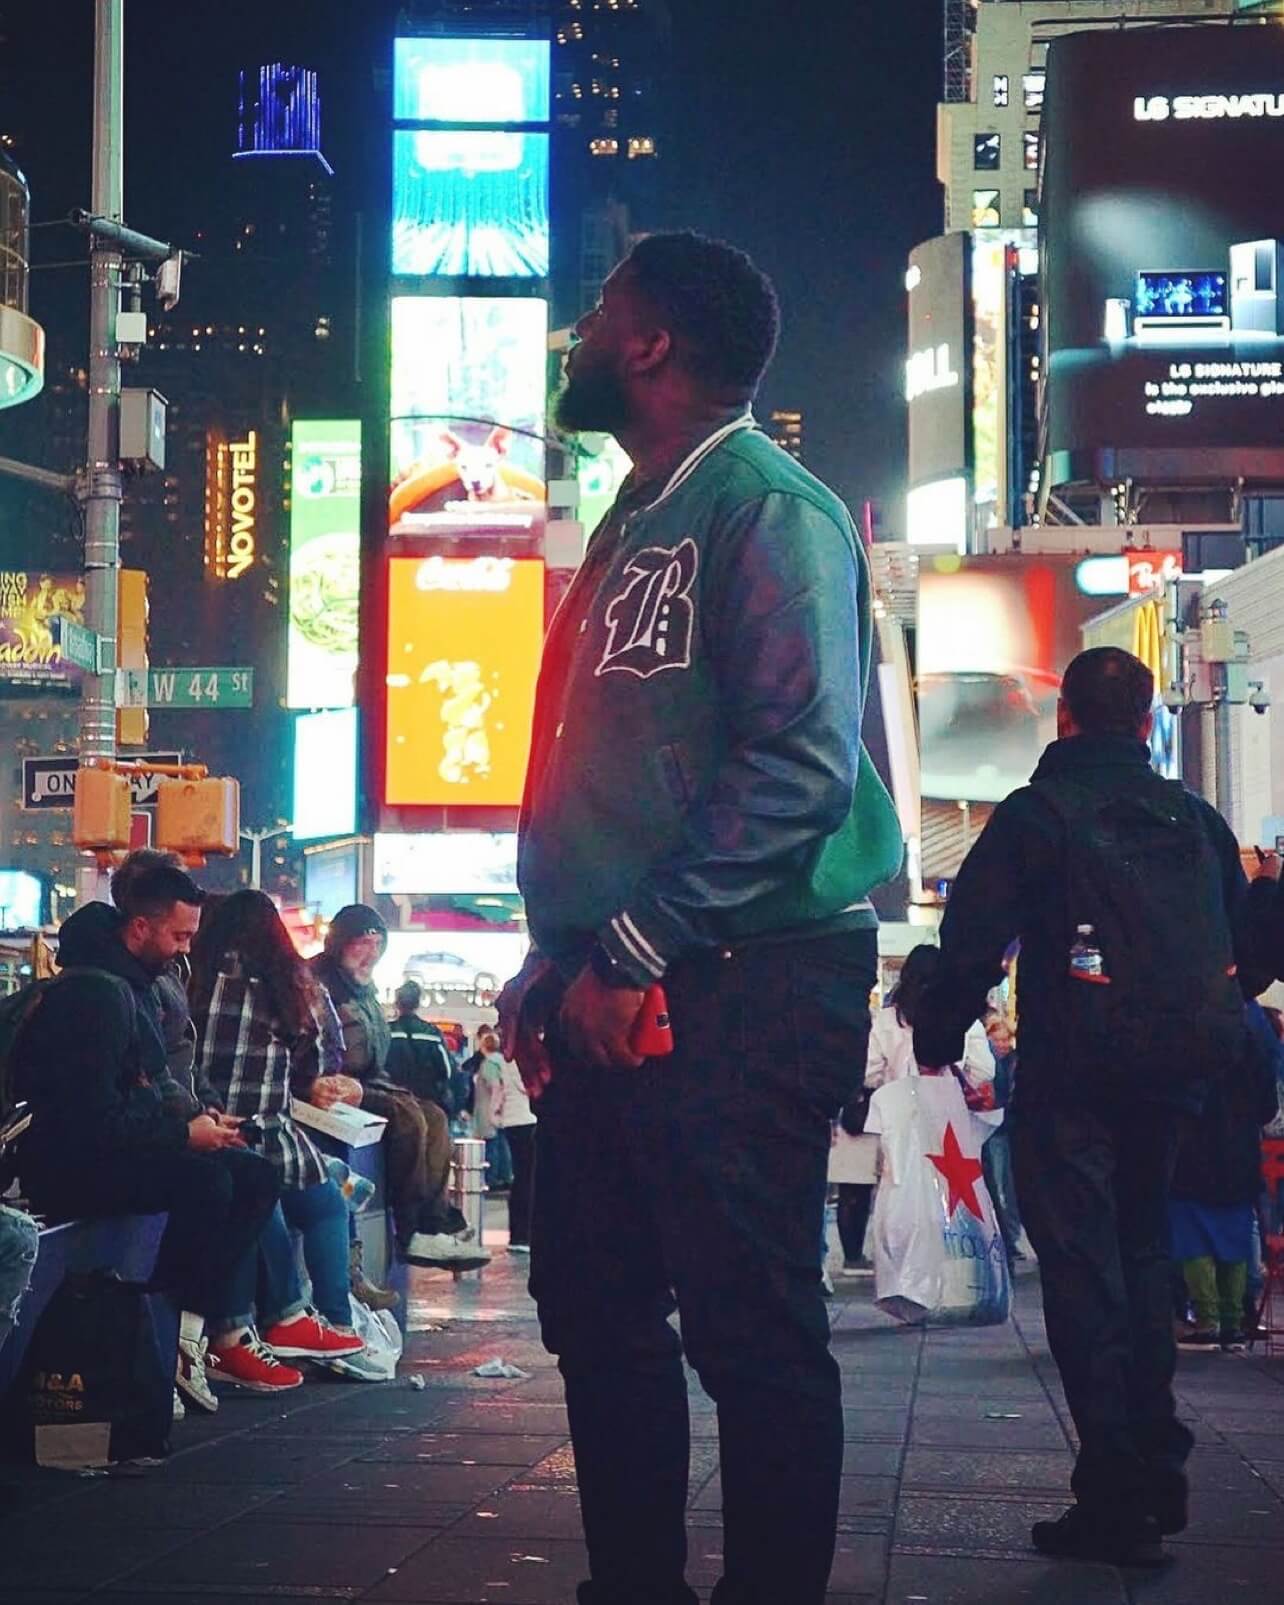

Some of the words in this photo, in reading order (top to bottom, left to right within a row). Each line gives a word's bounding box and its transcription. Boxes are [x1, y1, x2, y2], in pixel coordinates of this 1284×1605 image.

[1194, 362, 1282, 378] SIGNATURE
[227, 431, 256, 579] NOVOTEL
[153, 673, 175, 702] W
[188, 672, 220, 702] 44
[232, 672, 249, 692] St
[47, 774, 76, 793] ON
[130, 771, 152, 790] AY
